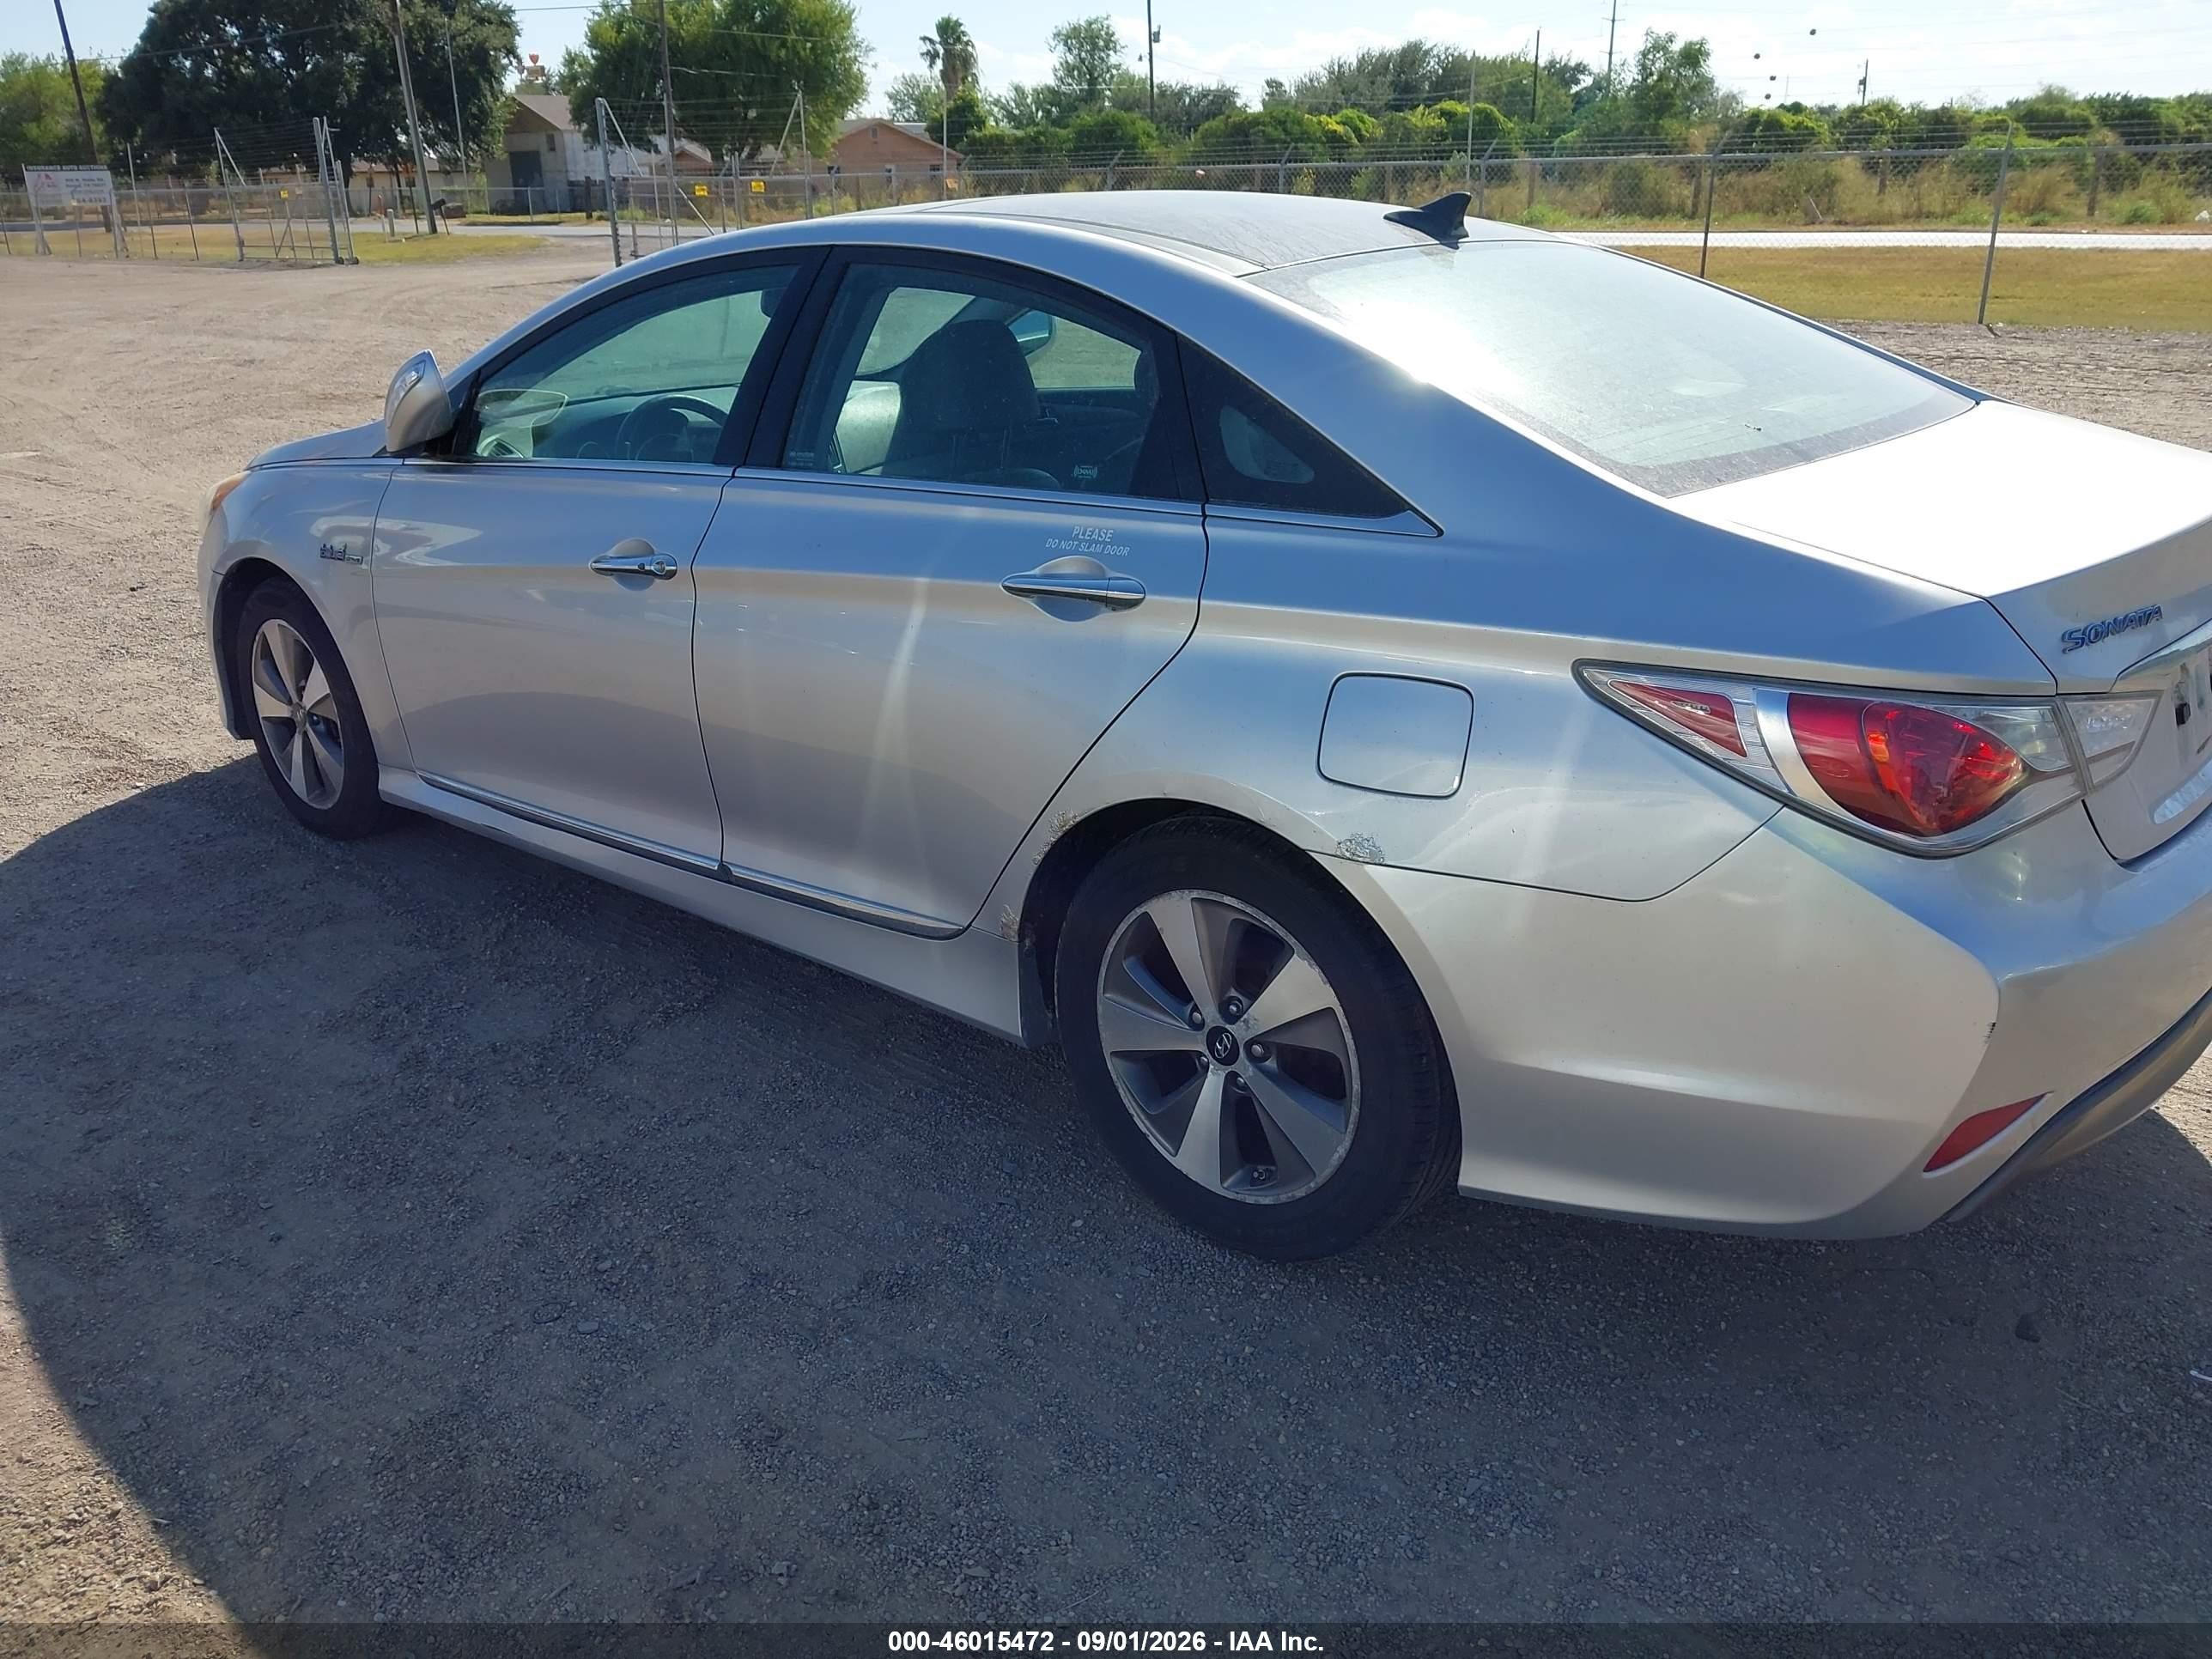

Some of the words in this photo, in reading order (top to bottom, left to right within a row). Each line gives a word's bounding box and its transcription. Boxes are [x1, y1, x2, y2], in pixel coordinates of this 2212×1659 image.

[1072, 526, 1114, 542] PLEASE
[1045, 538, 1059, 549] DO
[1059, 539, 1079, 550] NOT
[1079, 542, 1103, 553] SLAM
[1104, 544, 1131, 556] DOOR
[2061, 604, 2163, 654] SONATA
